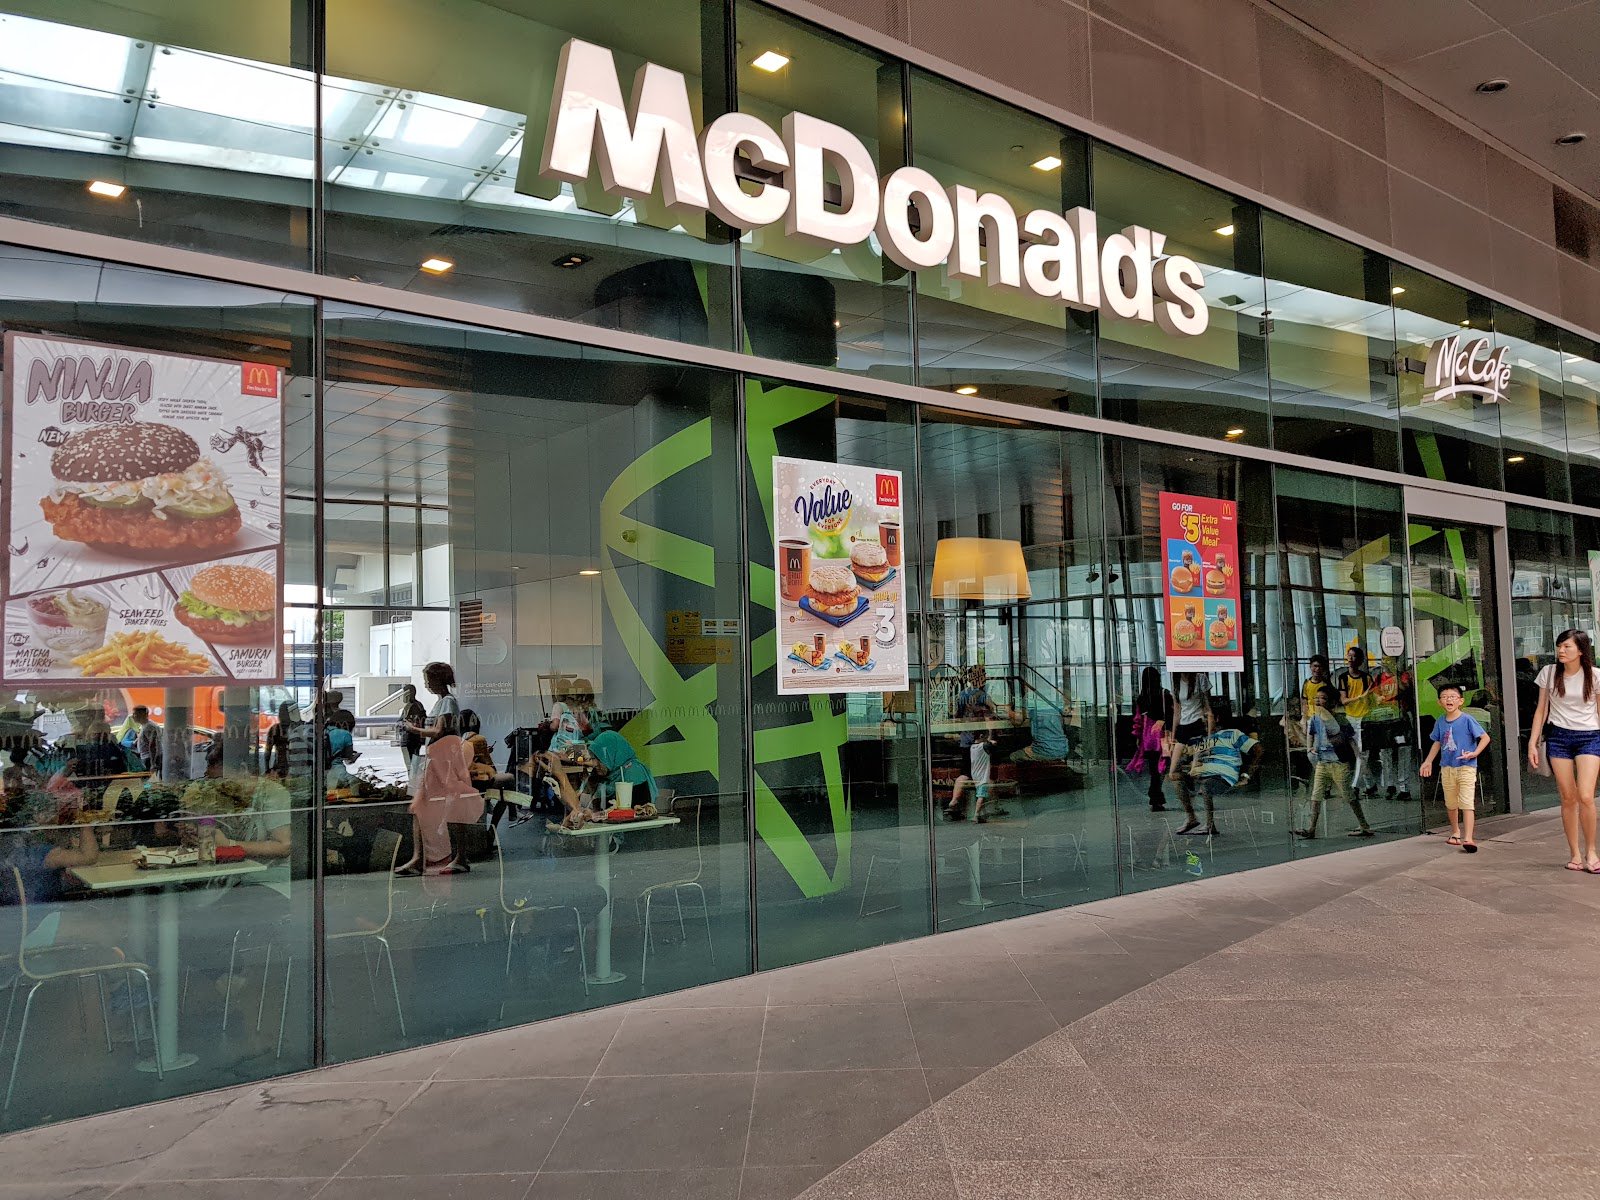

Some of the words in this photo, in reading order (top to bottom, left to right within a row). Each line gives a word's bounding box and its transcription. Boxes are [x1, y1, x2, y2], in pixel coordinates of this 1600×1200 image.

[540, 38, 1209, 337] McDonald's
[1433, 334, 1512, 403] McCafé
[26, 356, 153, 404] NINJA
[61, 401, 136, 424] BURGER
[38, 429, 70, 444] NEW
[810, 478, 837, 489] EVERYDAY
[794, 484, 853, 527] Value
[1181, 504, 1193, 512] FOR
[1201, 513, 1218, 525] Extra
[1181, 513, 1200, 543] $5
[1201, 525, 1219, 536] Value
[119, 608, 164, 619] SEAWEED
[124, 618, 149, 626] SHAKER
[15, 648, 50, 659] MATCHA
[229, 648, 272, 661] SAMURAI
[236, 660, 263, 668] BURGER
